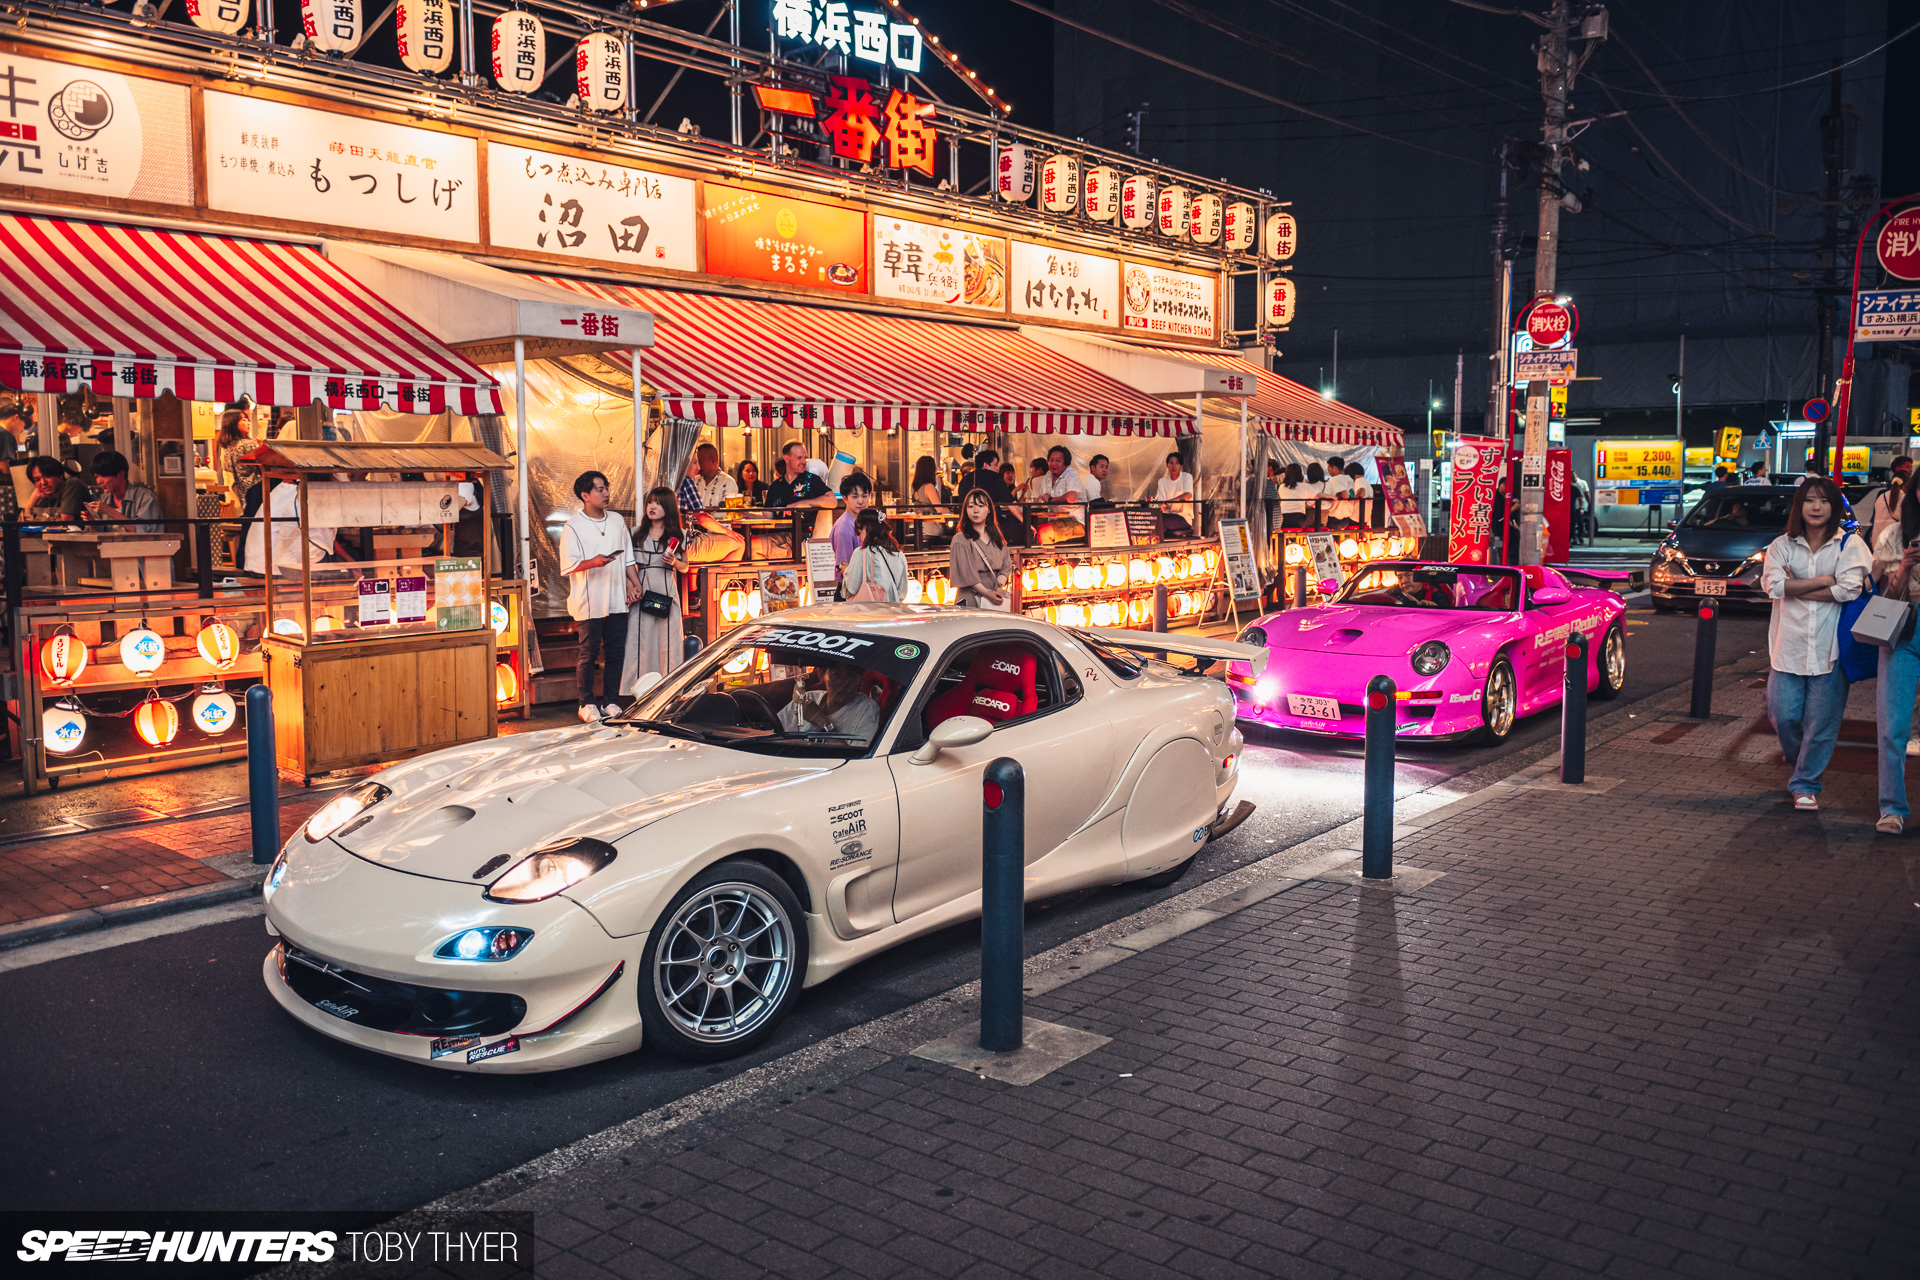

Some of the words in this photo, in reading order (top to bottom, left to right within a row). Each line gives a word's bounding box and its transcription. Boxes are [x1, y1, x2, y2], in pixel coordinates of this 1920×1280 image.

[516, 17, 537, 82] 横浜西口
[772, 0, 924, 73] 横浜西口
[604, 39, 623, 102] 横浜西口
[754, 75, 938, 178] 一番街
[310, 157, 463, 212] もつしげ
[524, 155, 663, 200] もつ煮込み専門店
[999, 147, 1014, 193] 一番街
[1022, 149, 1034, 194] 横浜西口
[1044, 160, 1057, 204] 一番街
[1066, 161, 1078, 205] 横浜西口
[1086, 170, 1100, 213] 一番街
[1108, 171, 1119, 213] 横浜西口
[1123, 179, 1137, 220] 一番街
[1145, 181, 1155, 221] 横浜西口
[537, 192, 650, 254] 沼田
[1160, 190, 1173, 230] 一番街
[1191, 198, 1203, 236] 一番街
[1210, 199, 1221, 237] 横浜西口
[1225, 206, 1237, 242] 一番街
[1244, 207, 1254, 244] 横浜西口
[1894, 217, 1910, 227] FIRE
[755, 236, 824, 258] 焼きそばセンター
[1277, 215, 1292, 256] 一番街
[771, 253, 809, 276] まるき
[883, 240, 926, 283] 韓
[1025, 279, 1099, 315] はなたれ
[1272, 282, 1287, 318] 一番街
[560, 312, 620, 338] 一番街
[1151, 319, 1167, 331] BEEF
[1168, 321, 1192, 334] KITCHEN
[1193, 325, 1212, 337] STAND
[1531, 314, 1567, 333] 消火栓
[1865, 312, 1918, 324] すみふ横浜
[19, 359, 159, 386] 横浜西口一番街
[1519, 352, 1575, 364] シティテラス横浜
[324, 381, 431, 403] 横浜西口一番街
[1220, 375, 1244, 391] 一番街
[750, 405, 818, 419] 横浜西口一番街
[1467, 447, 1501, 544] すごい煮干
[1450, 471, 1476, 564] ラーメン
[1702, 585, 1725, 595] 15-57
[756, 629, 875, 653] SCOOT
[990, 660, 1021, 676] ECARO
[972, 696, 1011, 712] RECARO
[1300, 704, 1336, 719] 23-61
[837, 808, 864, 823] SCOOT
[468, 1046, 506, 1061] RESCUE
[469, 1047, 487, 1056] AUTO
